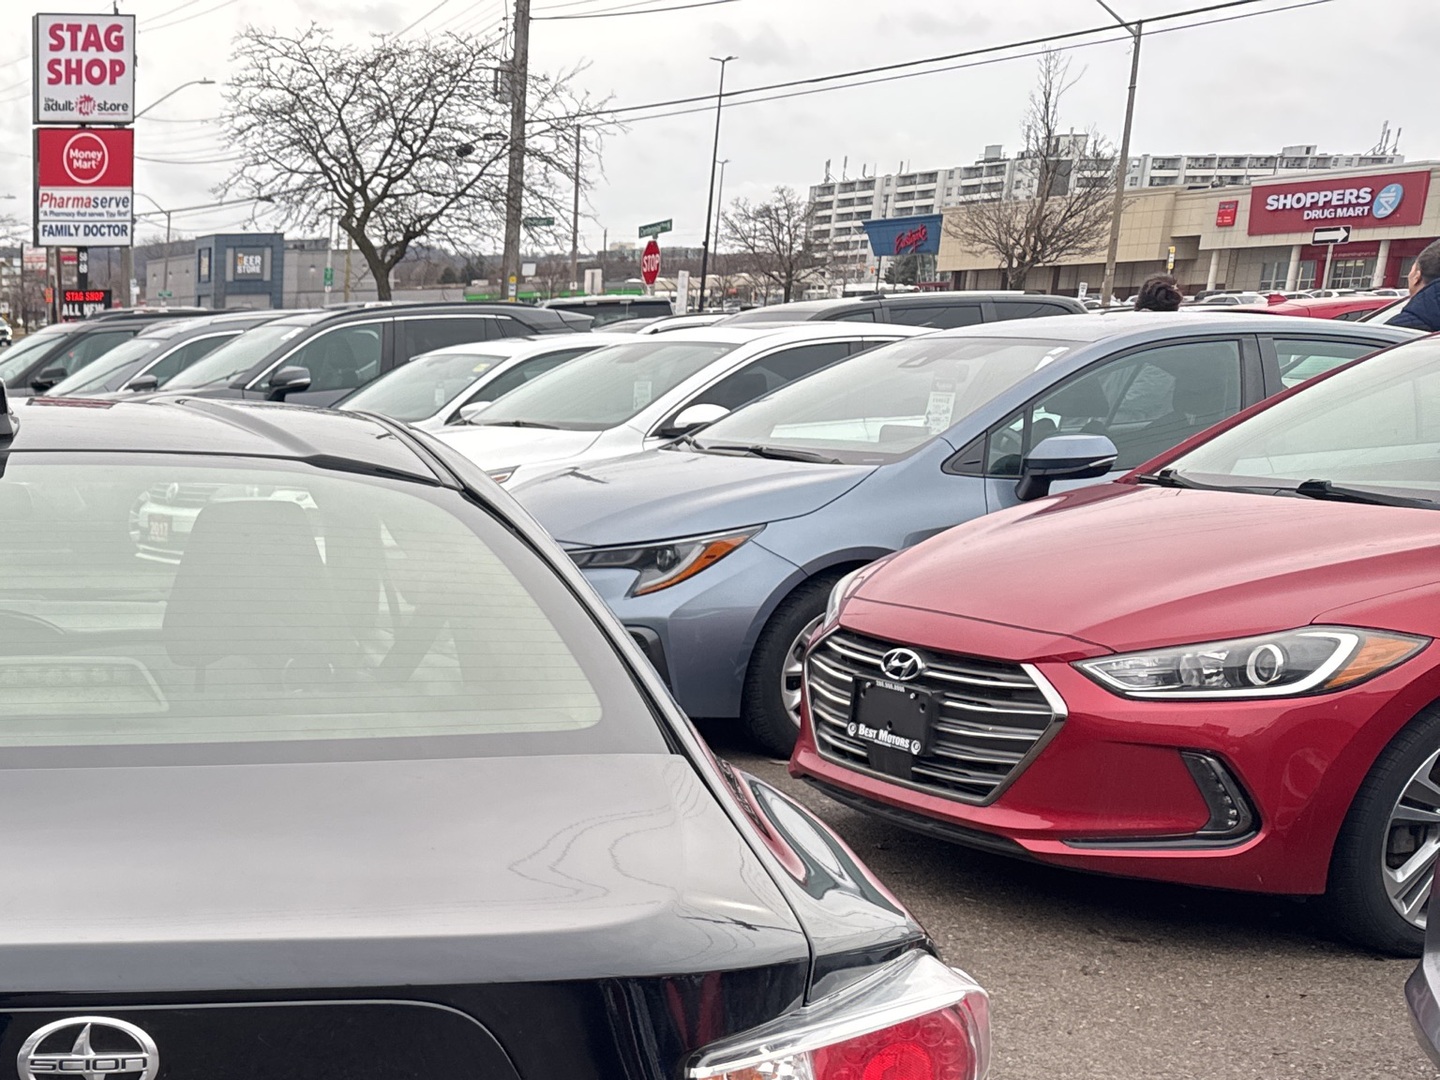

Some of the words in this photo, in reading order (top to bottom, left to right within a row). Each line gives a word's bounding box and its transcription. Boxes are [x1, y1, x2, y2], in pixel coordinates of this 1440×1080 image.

[48, 23, 124, 53] STAG
[47, 58, 126, 86] SHOP
[43, 101, 75, 112] adult
[97, 101, 129, 112] store
[69, 148, 102, 161] Money
[73, 160, 97, 169] Mart
[40, 193, 130, 208] Pharmaserve
[1265, 187, 1372, 211] SHOPPERS
[49, 210, 75, 218] Pharmacy
[1303, 208, 1335, 220] DRUG
[1336, 206, 1370, 218] MART
[42, 224, 80, 237] FAMILY
[83, 224, 128, 237] DOCTOR
[237, 266, 261, 274] STORE
[642, 253, 660, 273] STOP
[65, 291, 84, 301] STAG
[85, 291, 105, 301] SHOP
[62, 303, 81, 317] ALL
[858, 723, 878, 739] BEST
[878, 728, 910, 749] MOTORS
